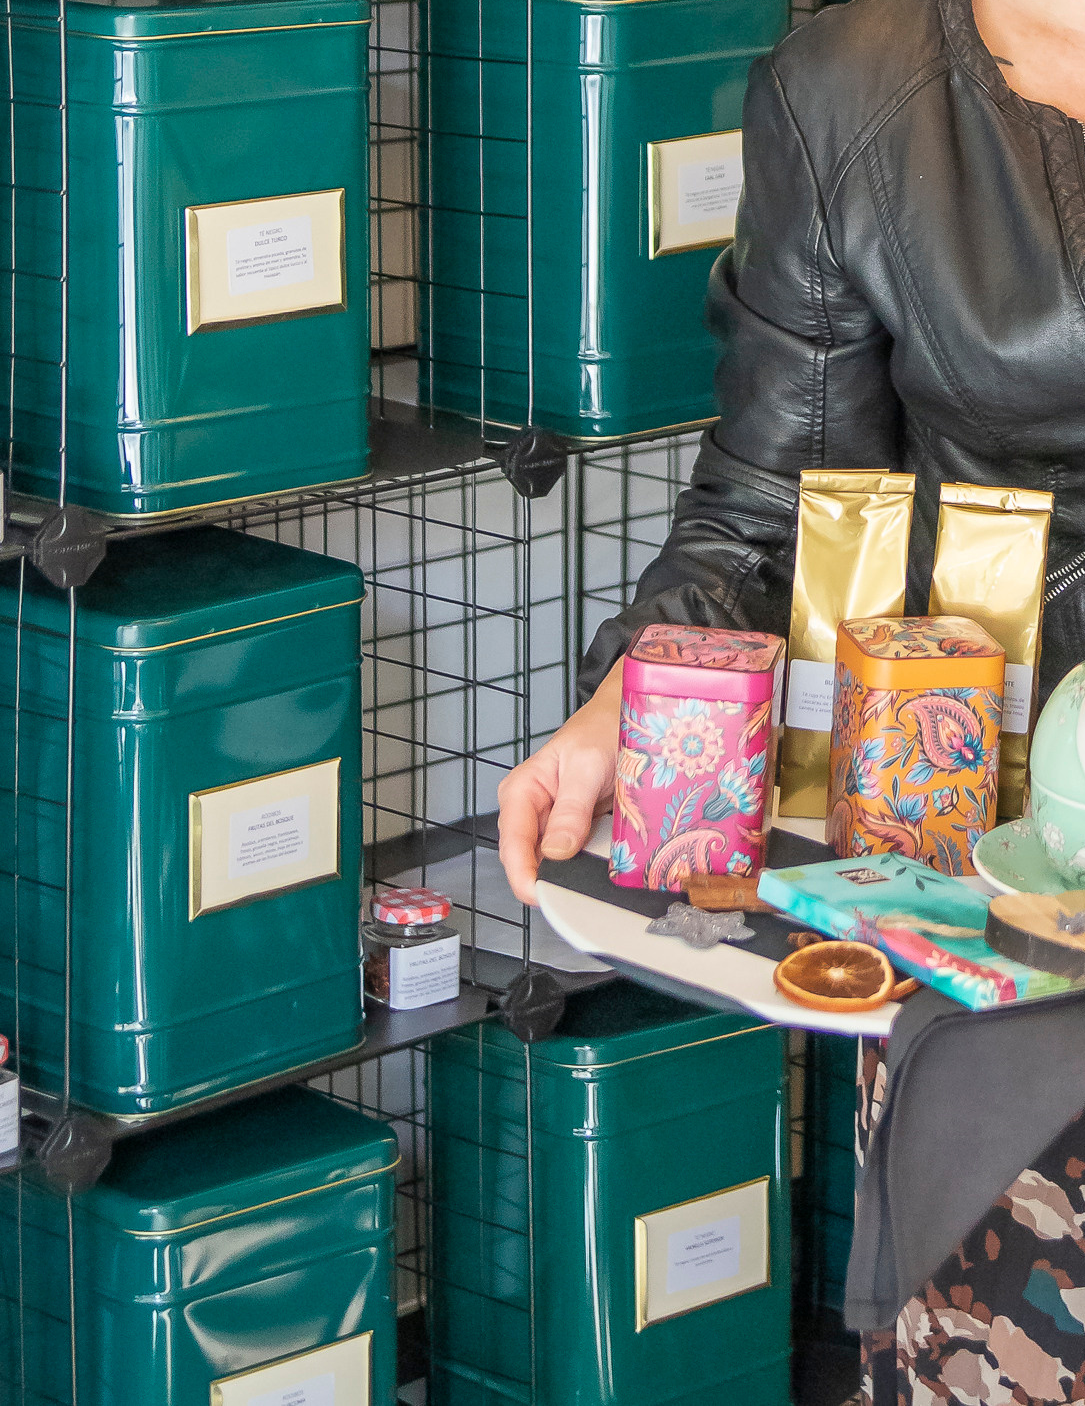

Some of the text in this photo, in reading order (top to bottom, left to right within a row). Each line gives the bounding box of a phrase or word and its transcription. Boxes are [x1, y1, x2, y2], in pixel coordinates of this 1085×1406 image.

[265, 227, 283, 235] NEGRO
[254, 235, 288, 246] DULCE TURCO
[248, 822, 266, 831] FRUTAS
[275, 815, 294, 824] BOSQUE
